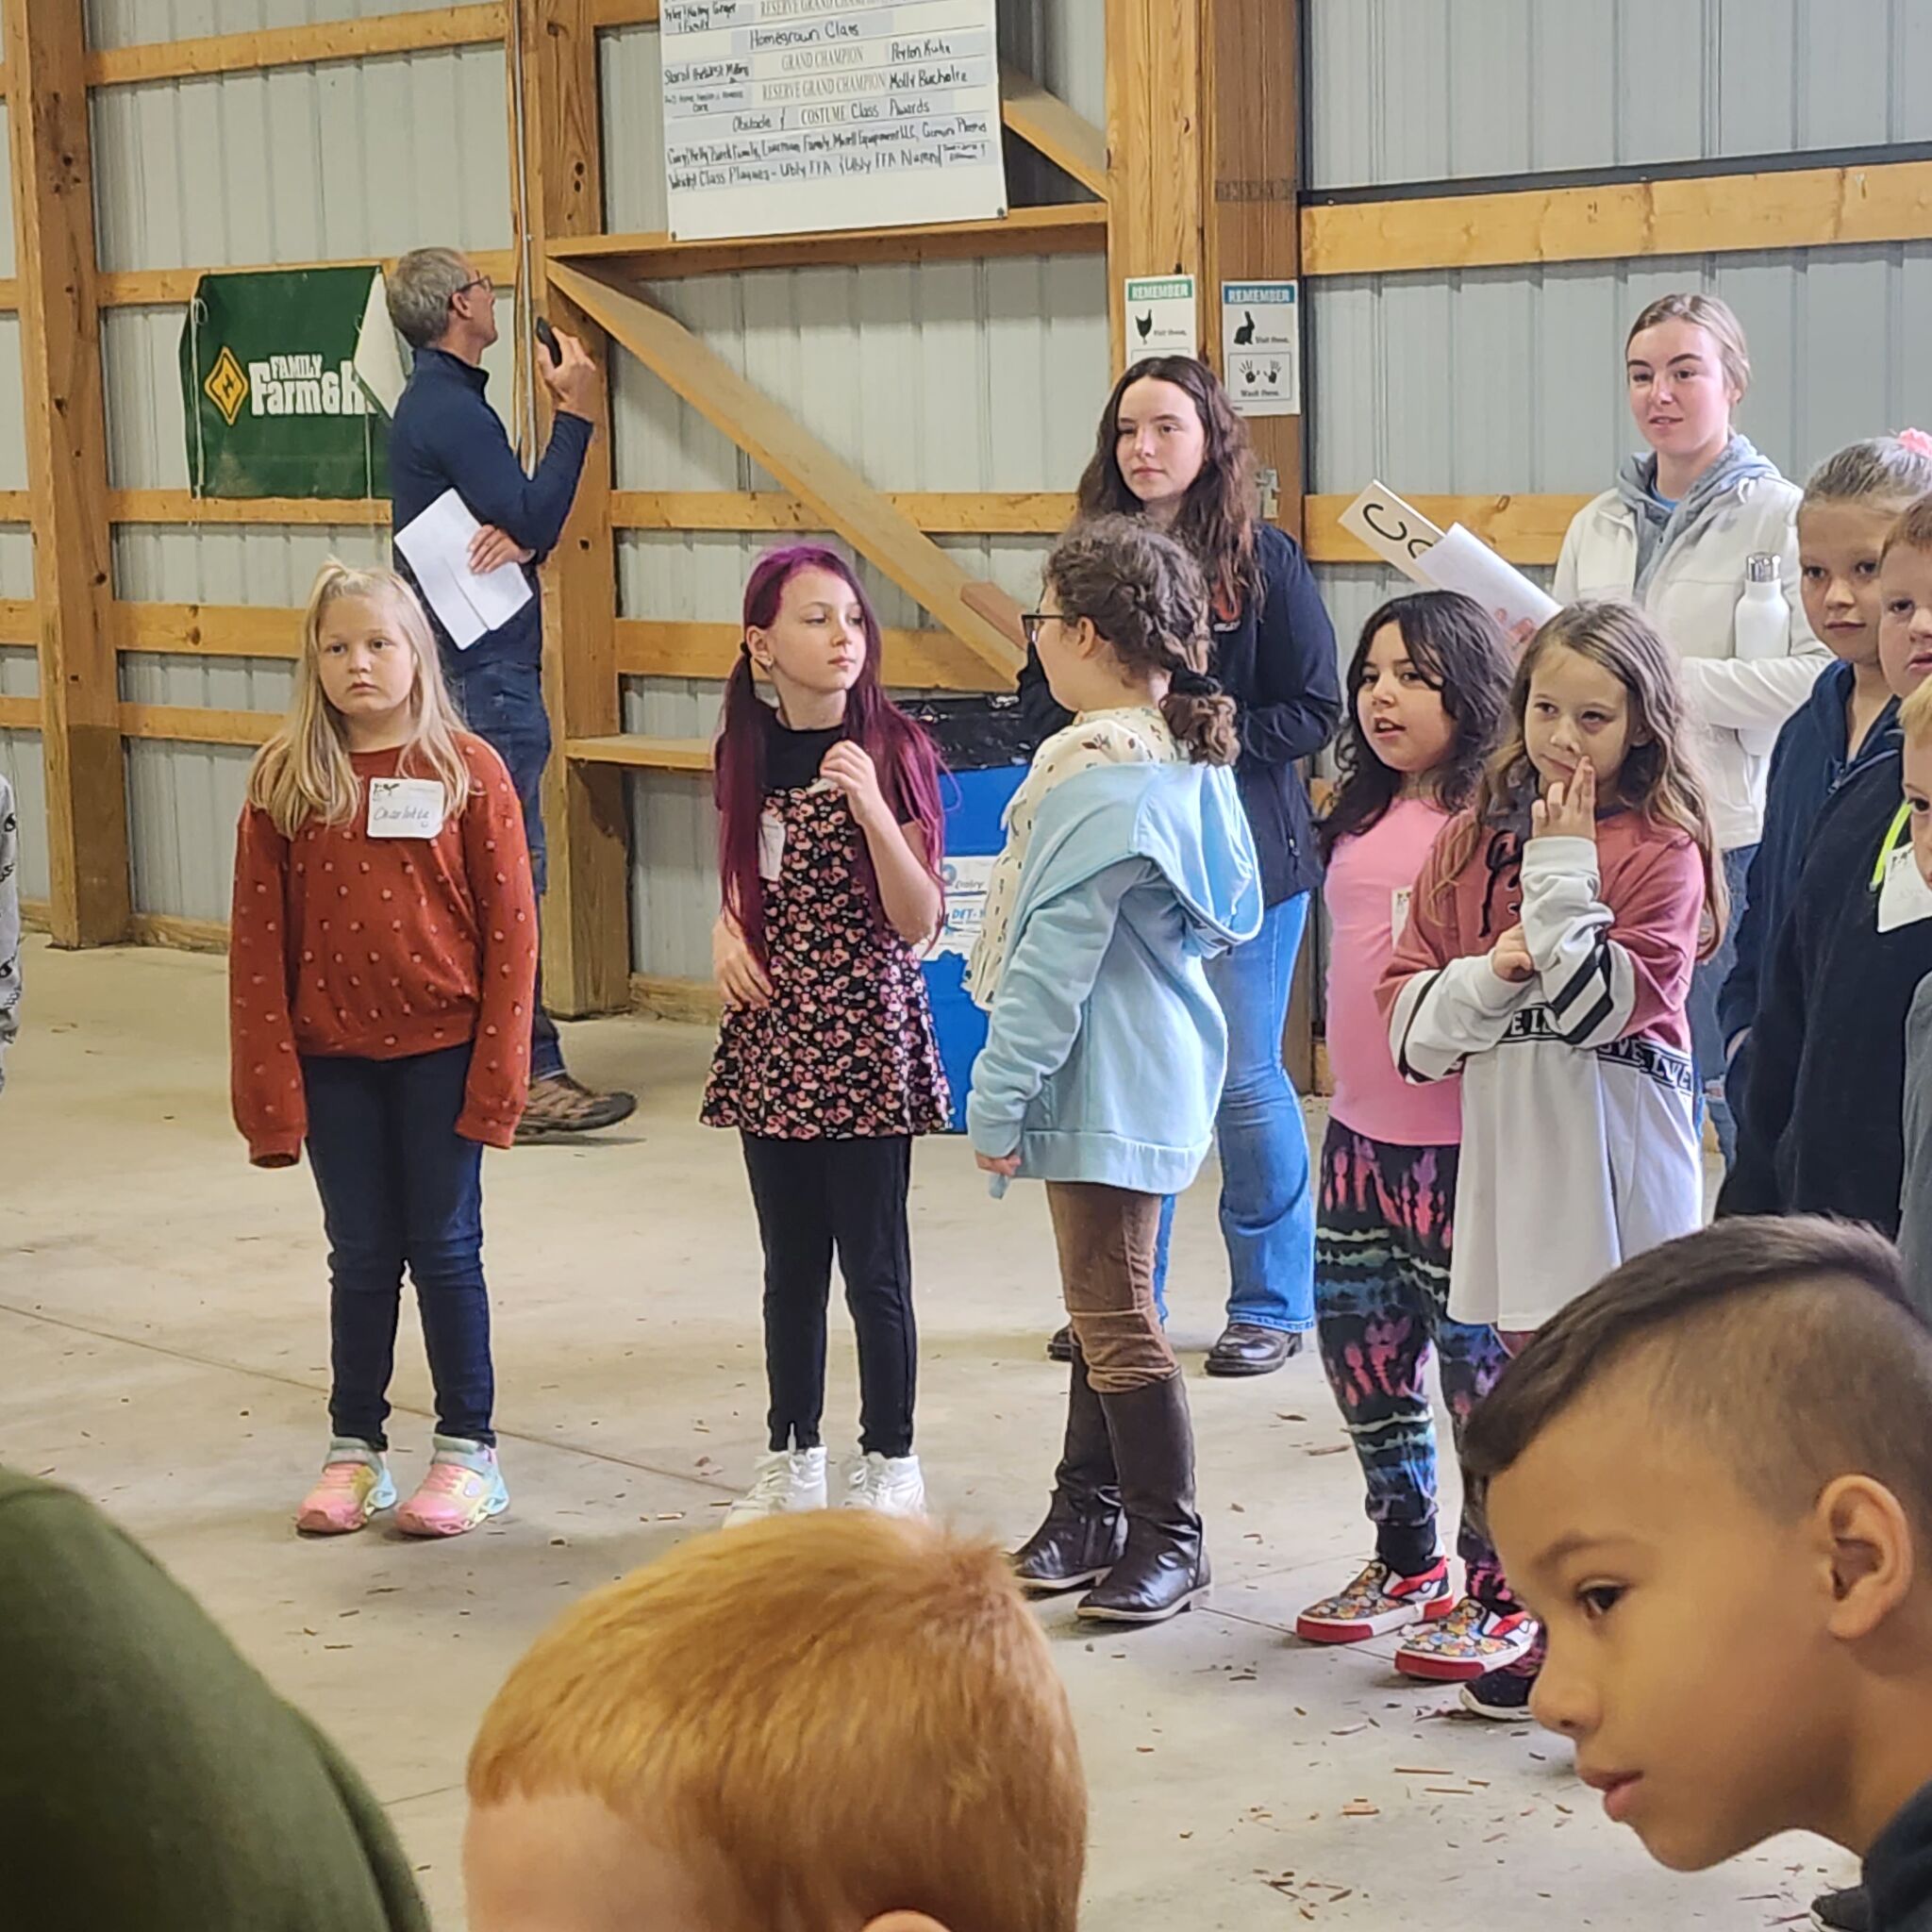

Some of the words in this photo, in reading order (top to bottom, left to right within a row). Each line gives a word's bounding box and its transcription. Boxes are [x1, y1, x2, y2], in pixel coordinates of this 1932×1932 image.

[749, 27, 820, 50] Homegrown
[824, 21, 859, 39] Class
[781, 50, 813, 71] GRAND
[815, 45, 863, 69] CHAMPION
[762, 80, 800, 101] RESERVE
[802, 78, 834, 97] GRAND
[836, 72, 886, 94] CHAMPION
[801, 105, 845, 125] COSTUME
[851, 103, 879, 119] Class
[890, 97, 930, 119] Awards
[699, 167, 726, 187] Class
[1132, 283, 1189, 300] REMEMBER
[1228, 289, 1291, 303] REMEMBER
[270, 354, 323, 379] FAMILY
